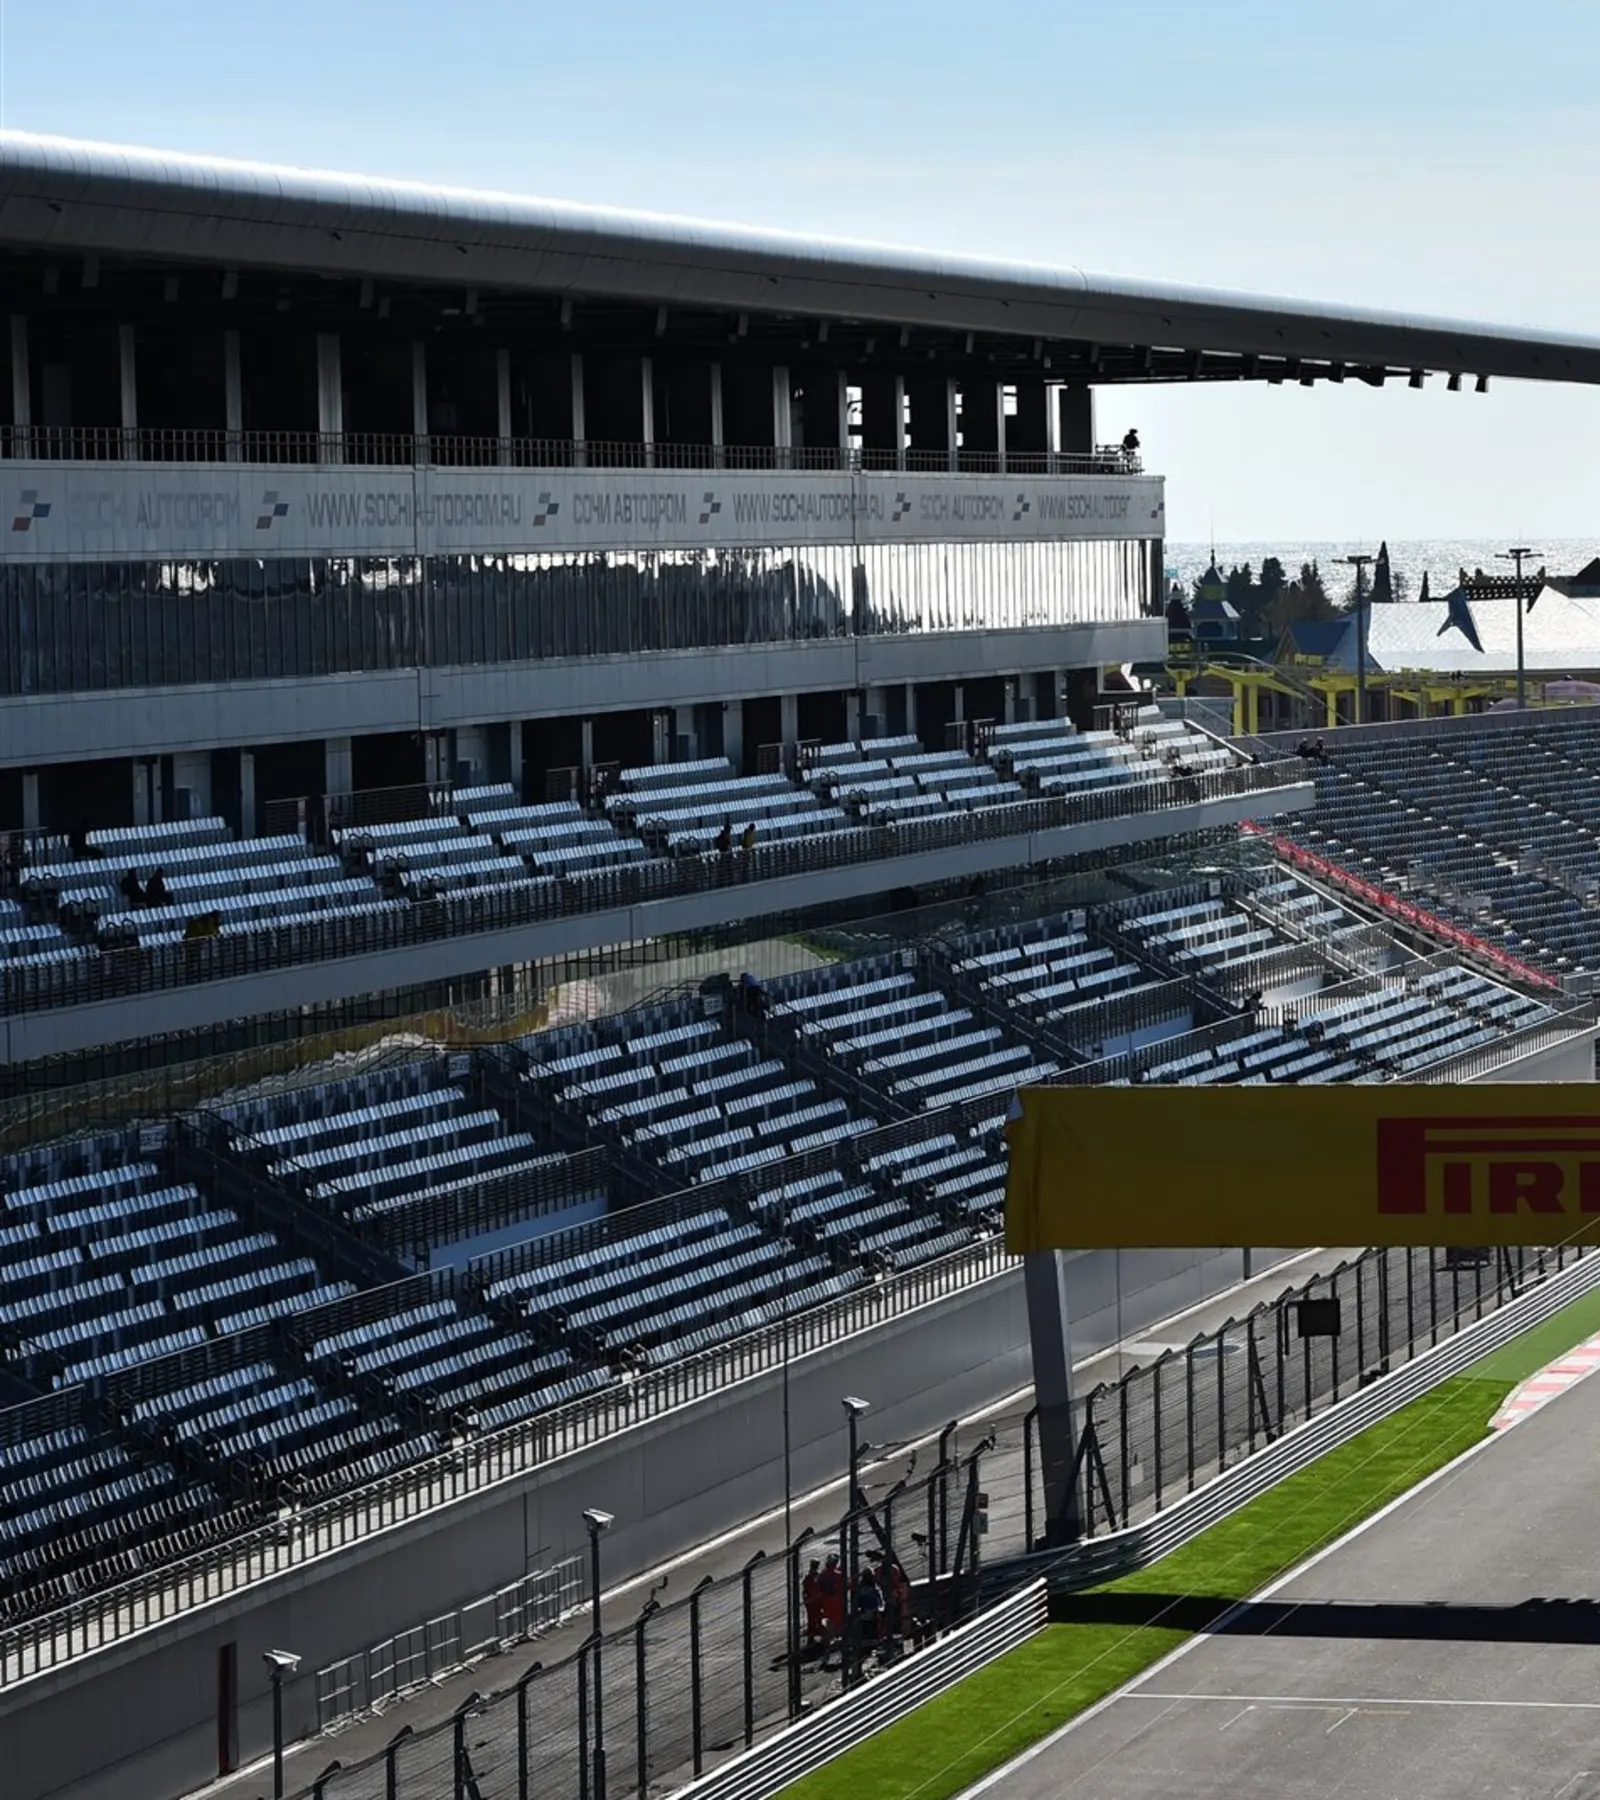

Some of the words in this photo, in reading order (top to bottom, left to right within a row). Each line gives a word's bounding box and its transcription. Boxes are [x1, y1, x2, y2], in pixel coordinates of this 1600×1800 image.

[136, 491, 241, 529] AUTODROM
[573, 493, 611, 524] СОЧИ
[613, 493, 687, 529] АВТОДРОМ
